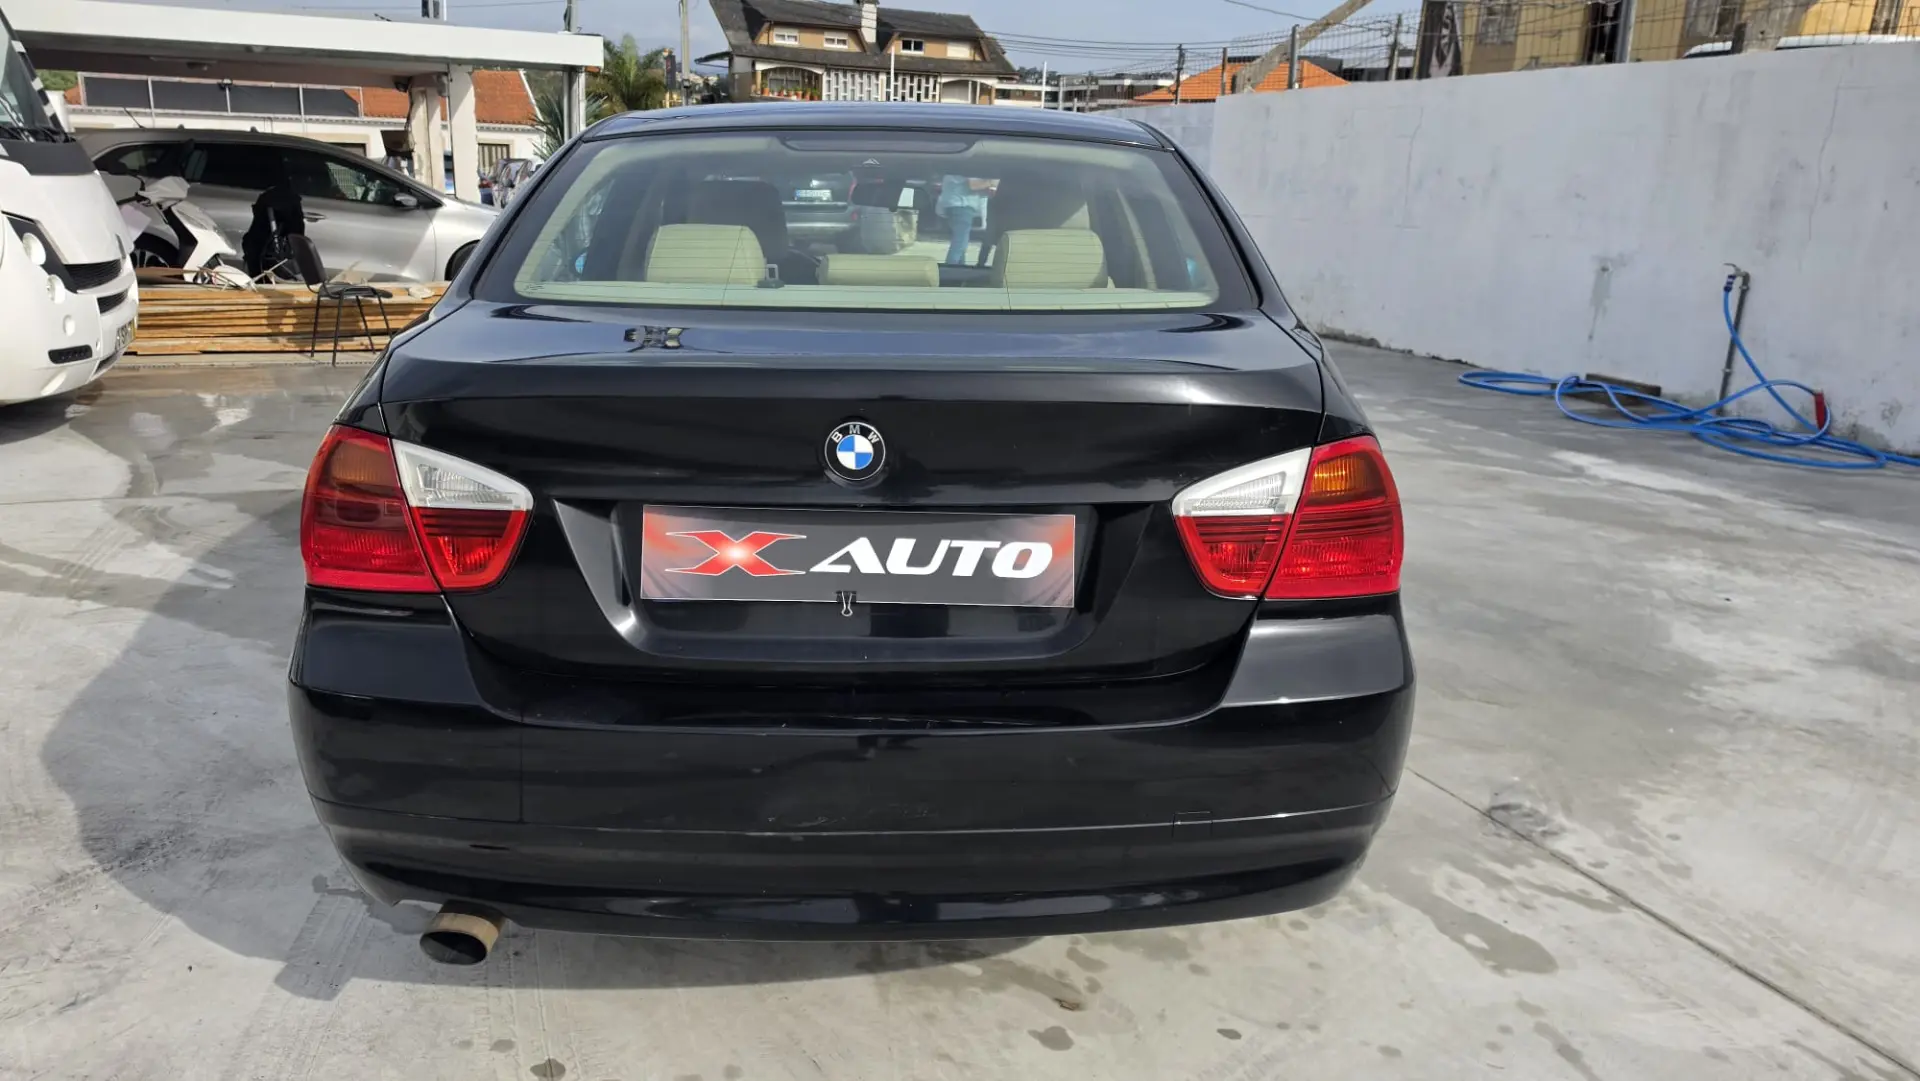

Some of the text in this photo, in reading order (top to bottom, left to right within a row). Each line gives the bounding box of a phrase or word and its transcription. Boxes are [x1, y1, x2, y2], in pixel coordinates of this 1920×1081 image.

[831, 424, 880, 443] BMW
[665, 530, 1053, 578] X AUTO
